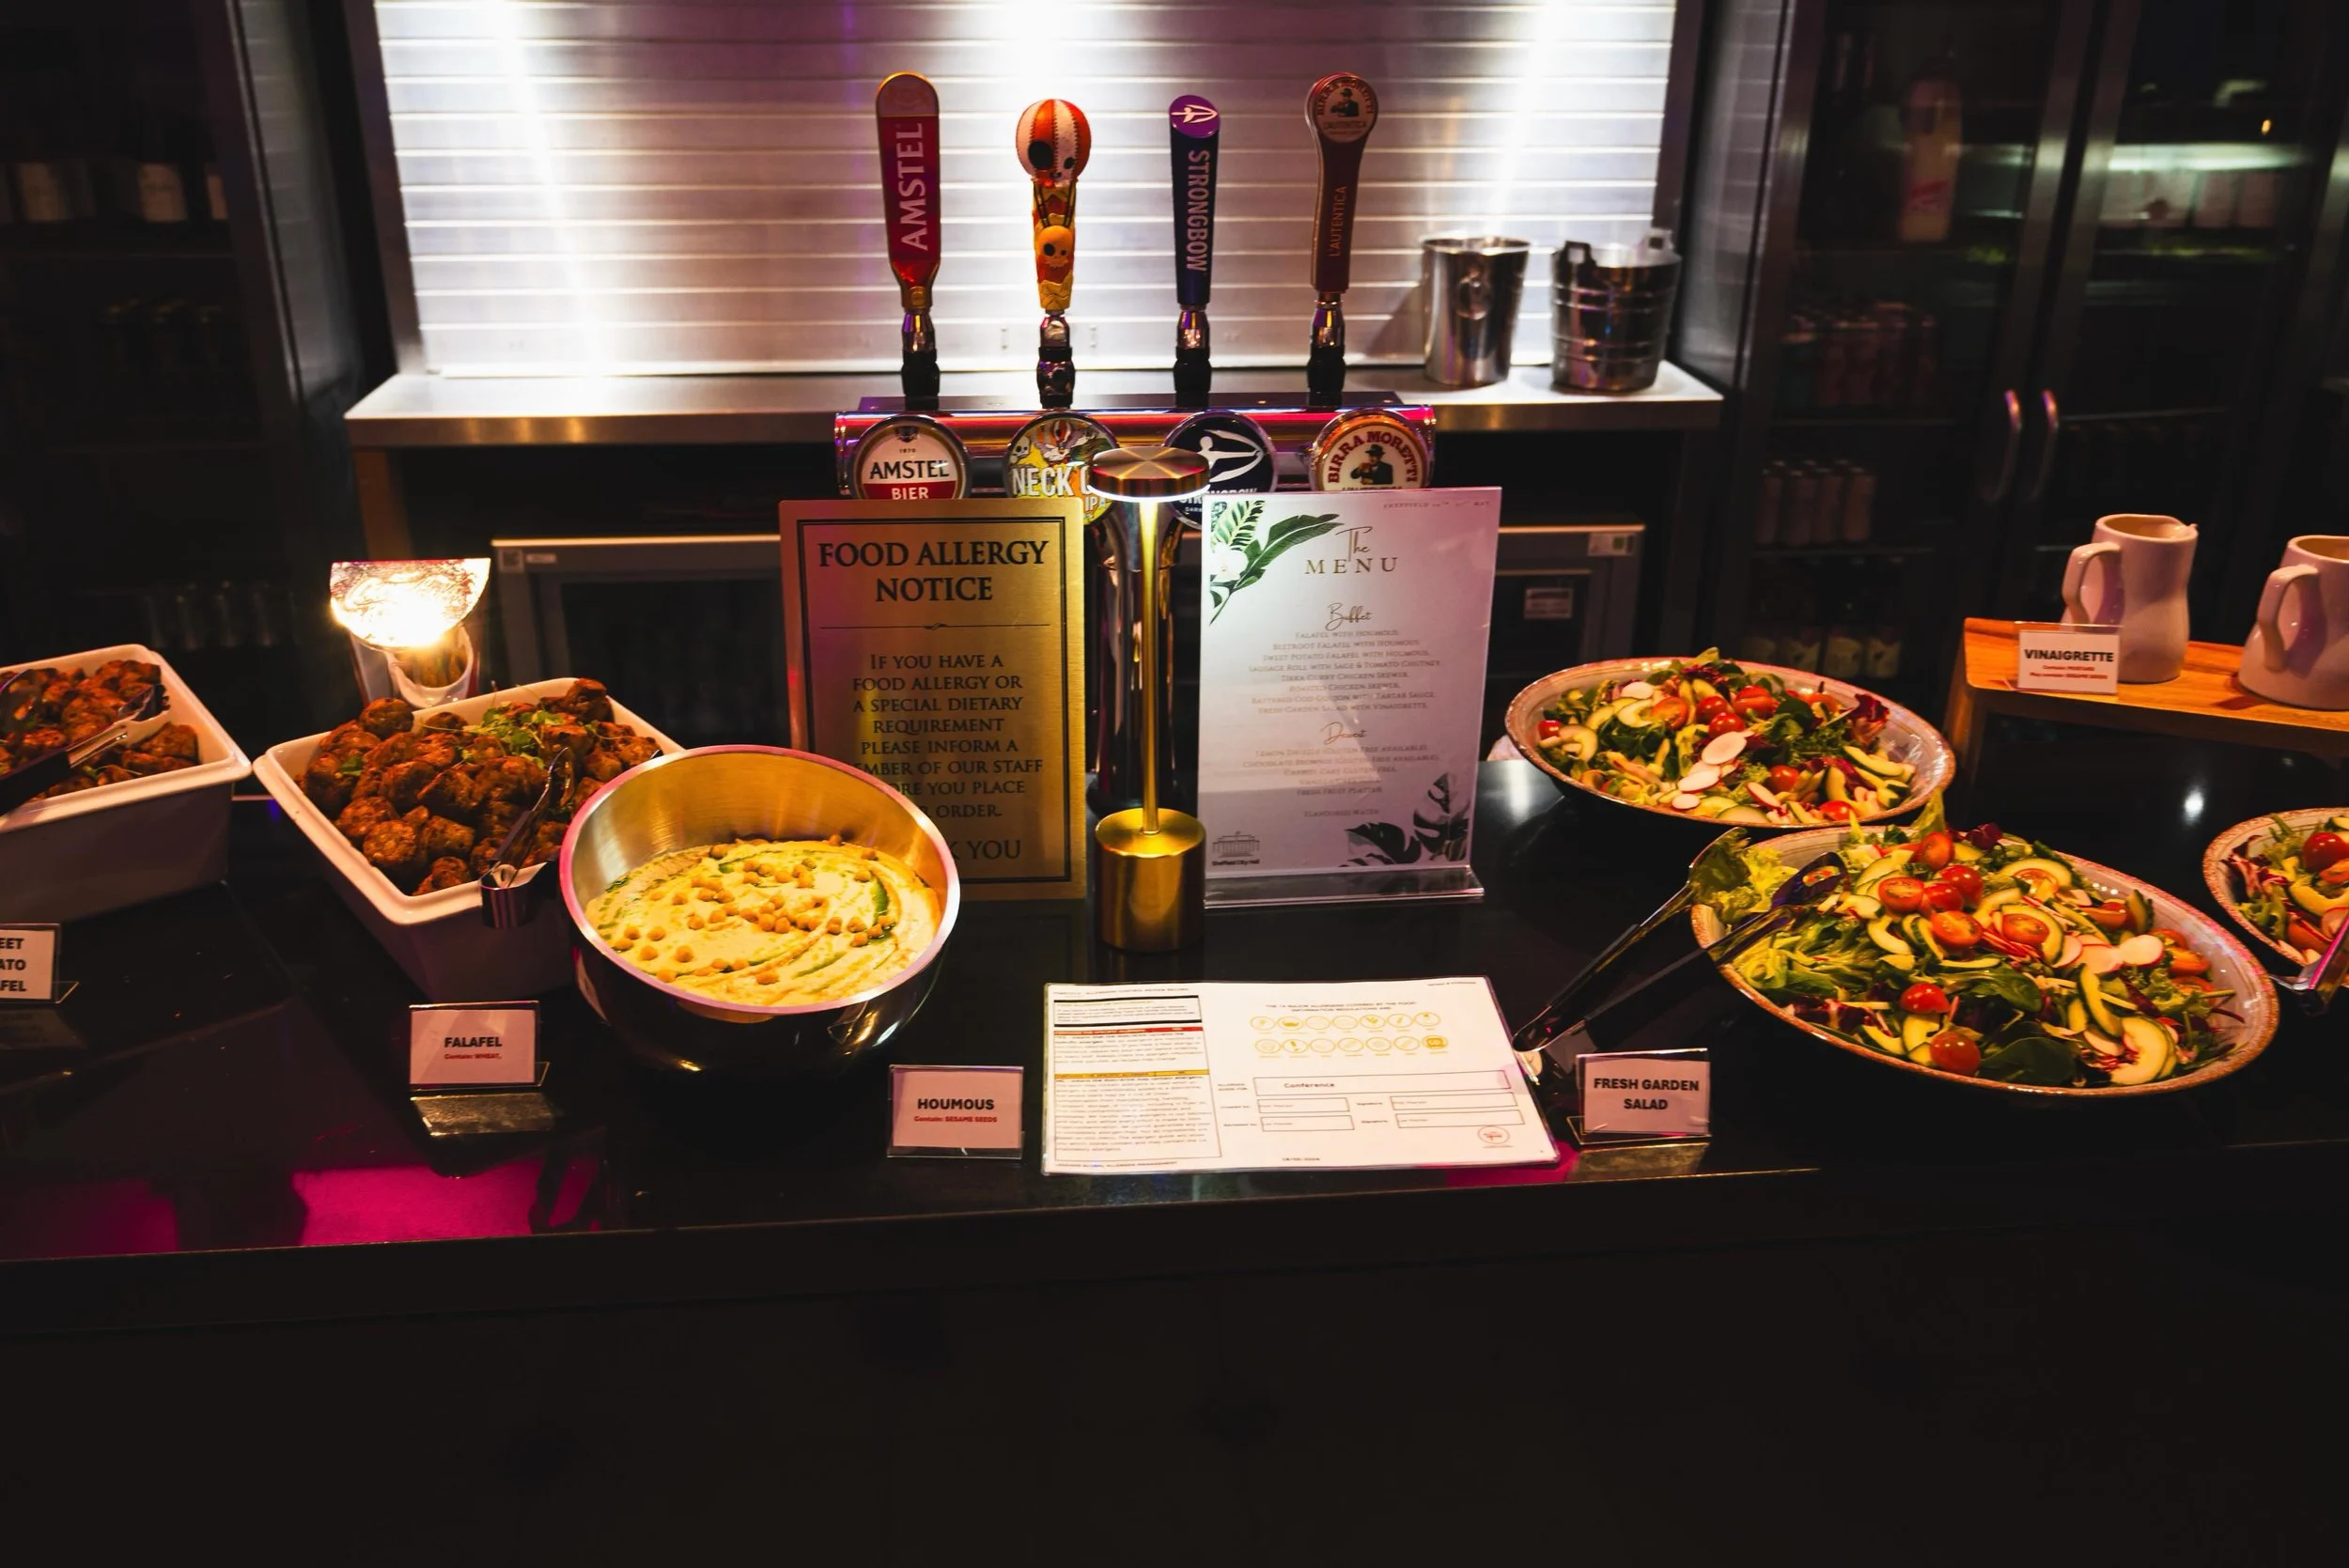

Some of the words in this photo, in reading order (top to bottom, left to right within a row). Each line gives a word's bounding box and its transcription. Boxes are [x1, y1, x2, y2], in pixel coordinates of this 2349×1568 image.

[895, 123, 929, 251] AMSTEL
[1186, 149, 1210, 272] STRONGBOW
[1328, 186, 1347, 257] L'AUTENTICA
[1328, 434, 1365, 483] BIRRA
[1366, 431, 1418, 482] MORETTI
[870, 460, 949, 479] AMSTEL
[1012, 465, 1074, 496] NECK
[891, 487, 929, 500] BIER
[1335, 526, 1373, 561] The
[818, 542, 910, 567] FOOD
[915, 541, 1049, 566] ALLERGY
[1305, 557, 1399, 574] MENU
[875, 577, 993, 602] NOTICE
[1325, 602, 1373, 631] Buffet
[892, 655, 932, 669] YOU
[940, 654, 985, 668] HAVE
[991, 655, 1004, 668] A
[2024, 649, 2114, 662] VINAIGRETTE
[853, 678, 905, 691] FOOD
[911, 676, 989, 691] ALLERGY
[995, 675, 1023, 689] OR
[853, 699, 864, 713] A
[871, 699, 942, 712] SPECIAL
[948, 697, 1024, 711] DIETARY
[873, 718, 1005, 736] REQUIREMENT
[861, 741, 920, 755] PLEASE
[927, 740, 1001, 753] INFORM
[1006, 739, 1019, 752] A
[856, 762, 913, 776] EMBER
[918, 761, 941, 775] OF
[948, 761, 989, 774] OUR
[993, 760, 1043, 773] STAFF
[892, 782, 922, 796] ORE
[927, 781, 965, 794] YOU
[972, 781, 1026, 794] PLACE
[935, 804, 1002, 818] ORDER.
[969, 840, 1021, 860] YOU
[0, 938, 24, 949] EET
[0, 959, 26, 970] ATO
[444, 1037, 502, 1048] FALAFEL
[1594, 1078, 1638, 1089] FRESH
[1641, 1079, 1699, 1091] GARDEN
[917, 1098, 995, 1110] HOUMOUS
[1624, 1098, 1668, 1110] SALAD
